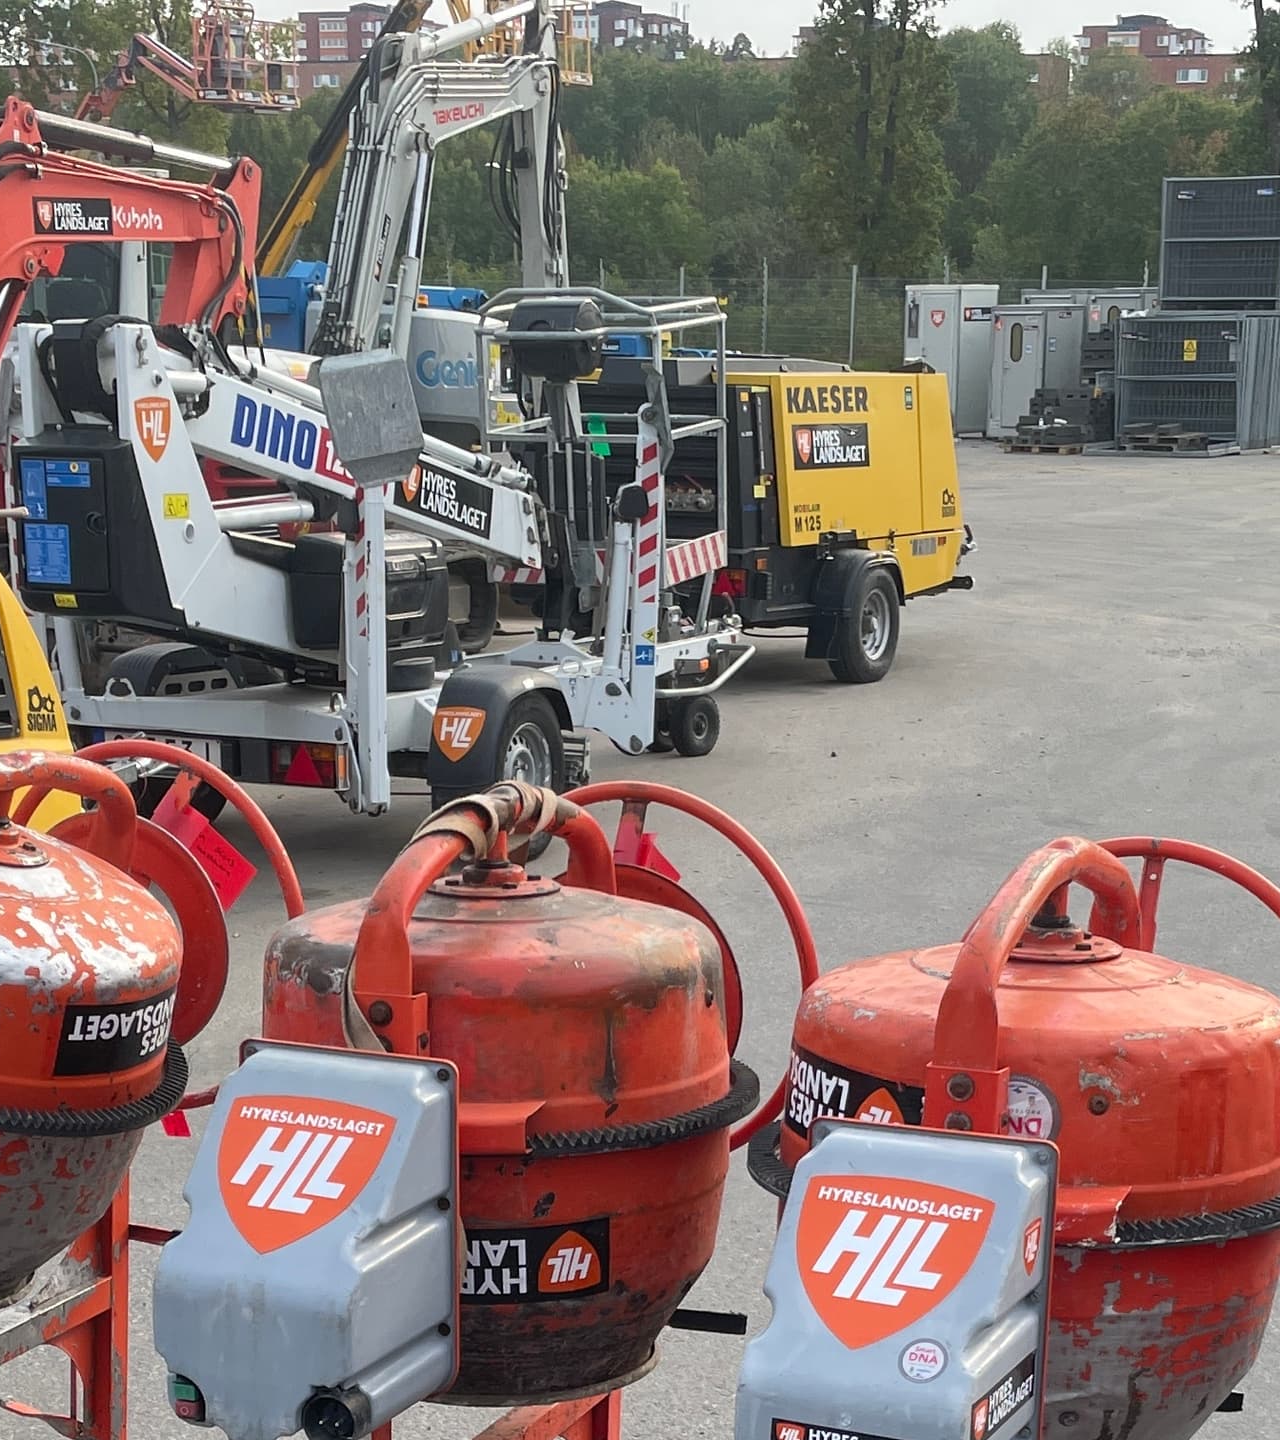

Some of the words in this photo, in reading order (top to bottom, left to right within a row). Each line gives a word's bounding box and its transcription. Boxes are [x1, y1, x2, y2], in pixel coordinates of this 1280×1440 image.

[432, 103, 485, 125] TAKEUCHI
[53, 202, 82, 217] HYRES
[54, 216, 109, 231] LANDSLAGET
[112, 206, 163, 230] Kubota
[415, 350, 478, 389] Geni
[786, 385, 869, 413] KAESER
[230, 393, 318, 471] DINO
[812, 429, 841, 447] HYRES
[813, 445, 865, 464] LANDSLAGET
[422, 469, 457, 500] HYRES
[420, 491, 487, 531] LANDSLAGET
[794, 516, 803, 532] M
[805, 515, 822, 531] 125
[27, 713, 57, 732] SIGMA
[239, 1105, 385, 1137] HYRESLANDSLAGET
[1008, 1116, 1042, 1137] DN
[230, 1126, 354, 1215] HLL
[817, 1185, 984, 1222] HYRESLANDSLAGET
[466, 1238, 527, 1267] LAN
[811, 1208, 950, 1307] HLL
[459, 1267, 528, 1296] HYR
[908, 1351, 939, 1365] DNA
[988, 1376, 1014, 1413] HYRES
[988, 1374, 1034, 1432] LANDSLAGET
